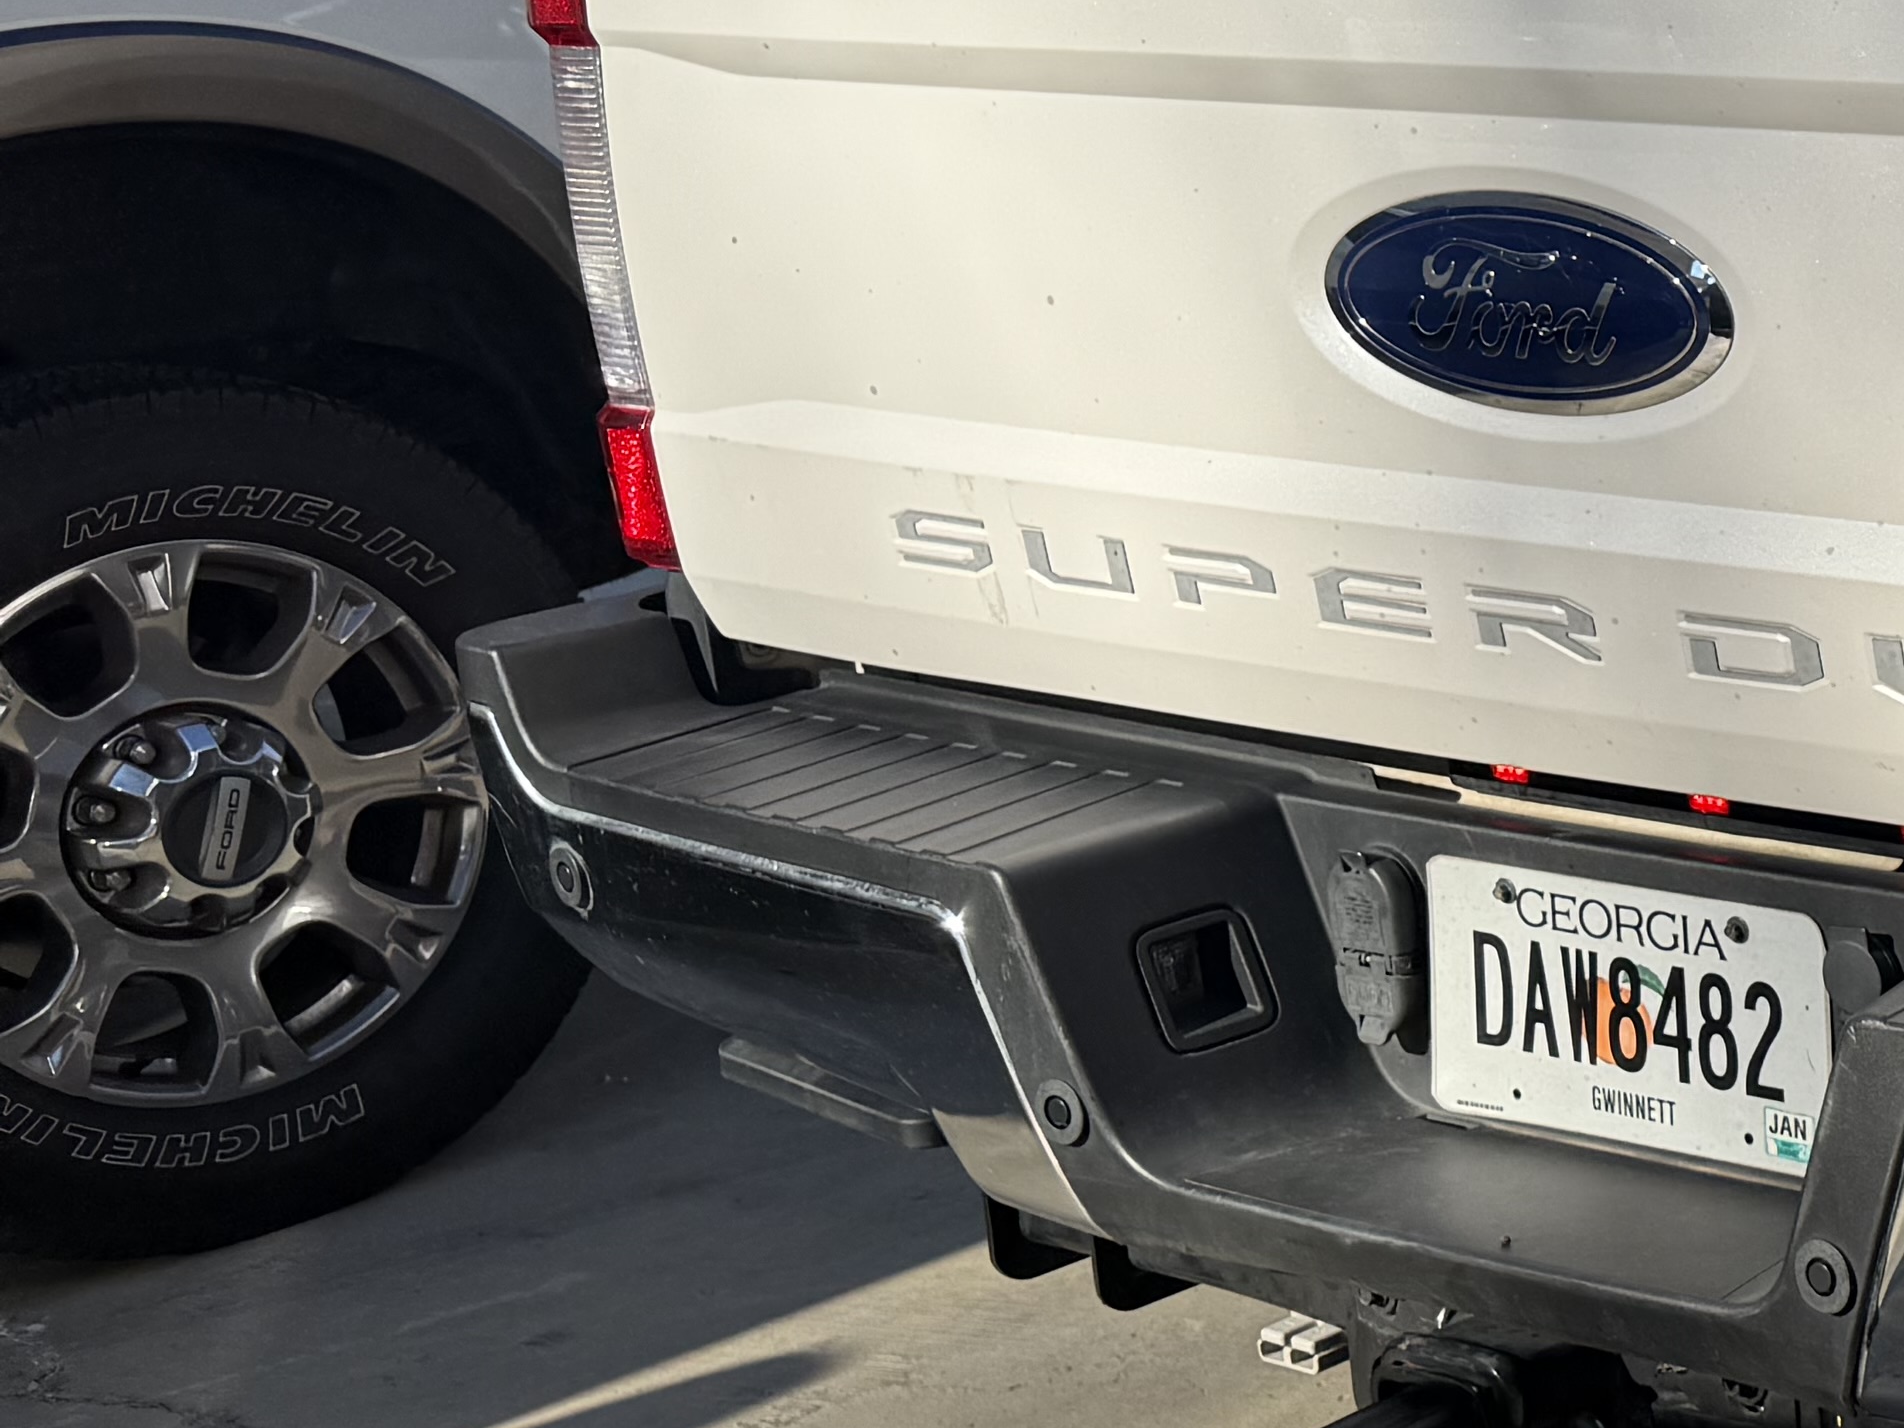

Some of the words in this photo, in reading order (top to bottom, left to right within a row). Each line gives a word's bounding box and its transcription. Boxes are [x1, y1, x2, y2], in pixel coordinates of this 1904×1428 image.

[1409, 237, 1619, 366] Ford
[63, 484, 457, 587] MICHELIN
[890, 508, 1605, 667] SUPER
[215, 788, 240, 870] FORD
[1516, 887, 1728, 961] GEORGIA
[1472, 930, 1786, 1103] DAW8482
[0, 1083, 365, 1169] MICHELIN
[1591, 1085, 1677, 1127] GWINNETT
[1768, 1113, 1807, 1141] JAN
